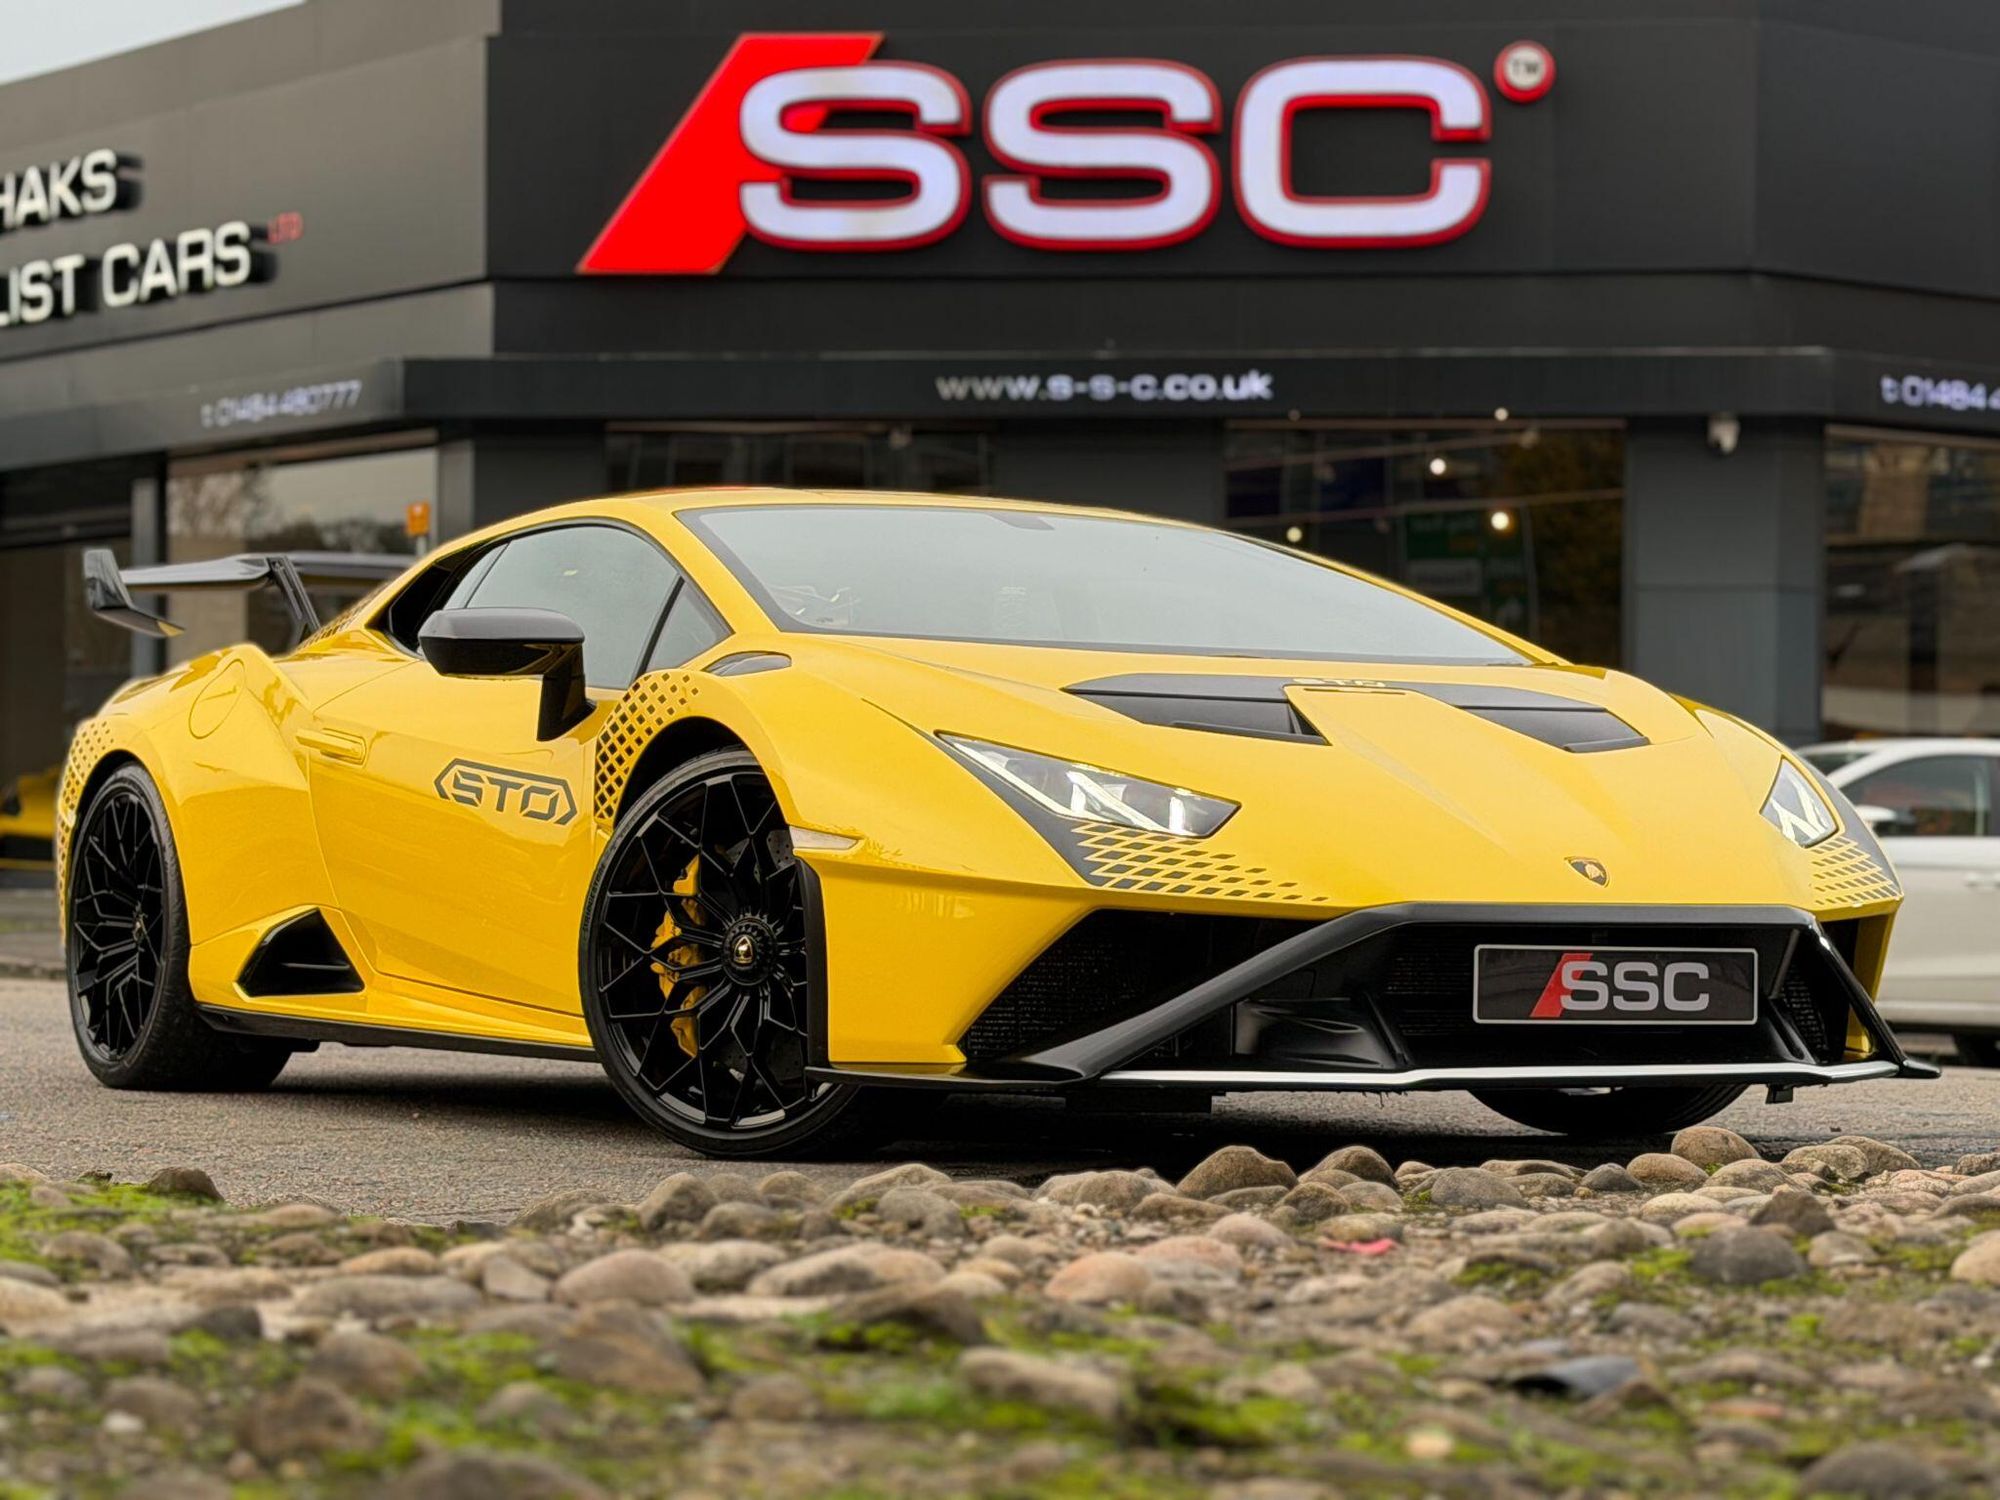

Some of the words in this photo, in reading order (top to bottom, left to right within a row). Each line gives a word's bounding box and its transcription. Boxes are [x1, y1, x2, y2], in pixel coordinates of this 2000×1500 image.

[738, 56, 1491, 250] SSC
[103, 221, 251, 307] CARS
[935, 368, 1274, 402] www.s-s-c.co.uk
[451, 769, 561, 822] STO
[1559, 961, 1710, 1012] SSC
